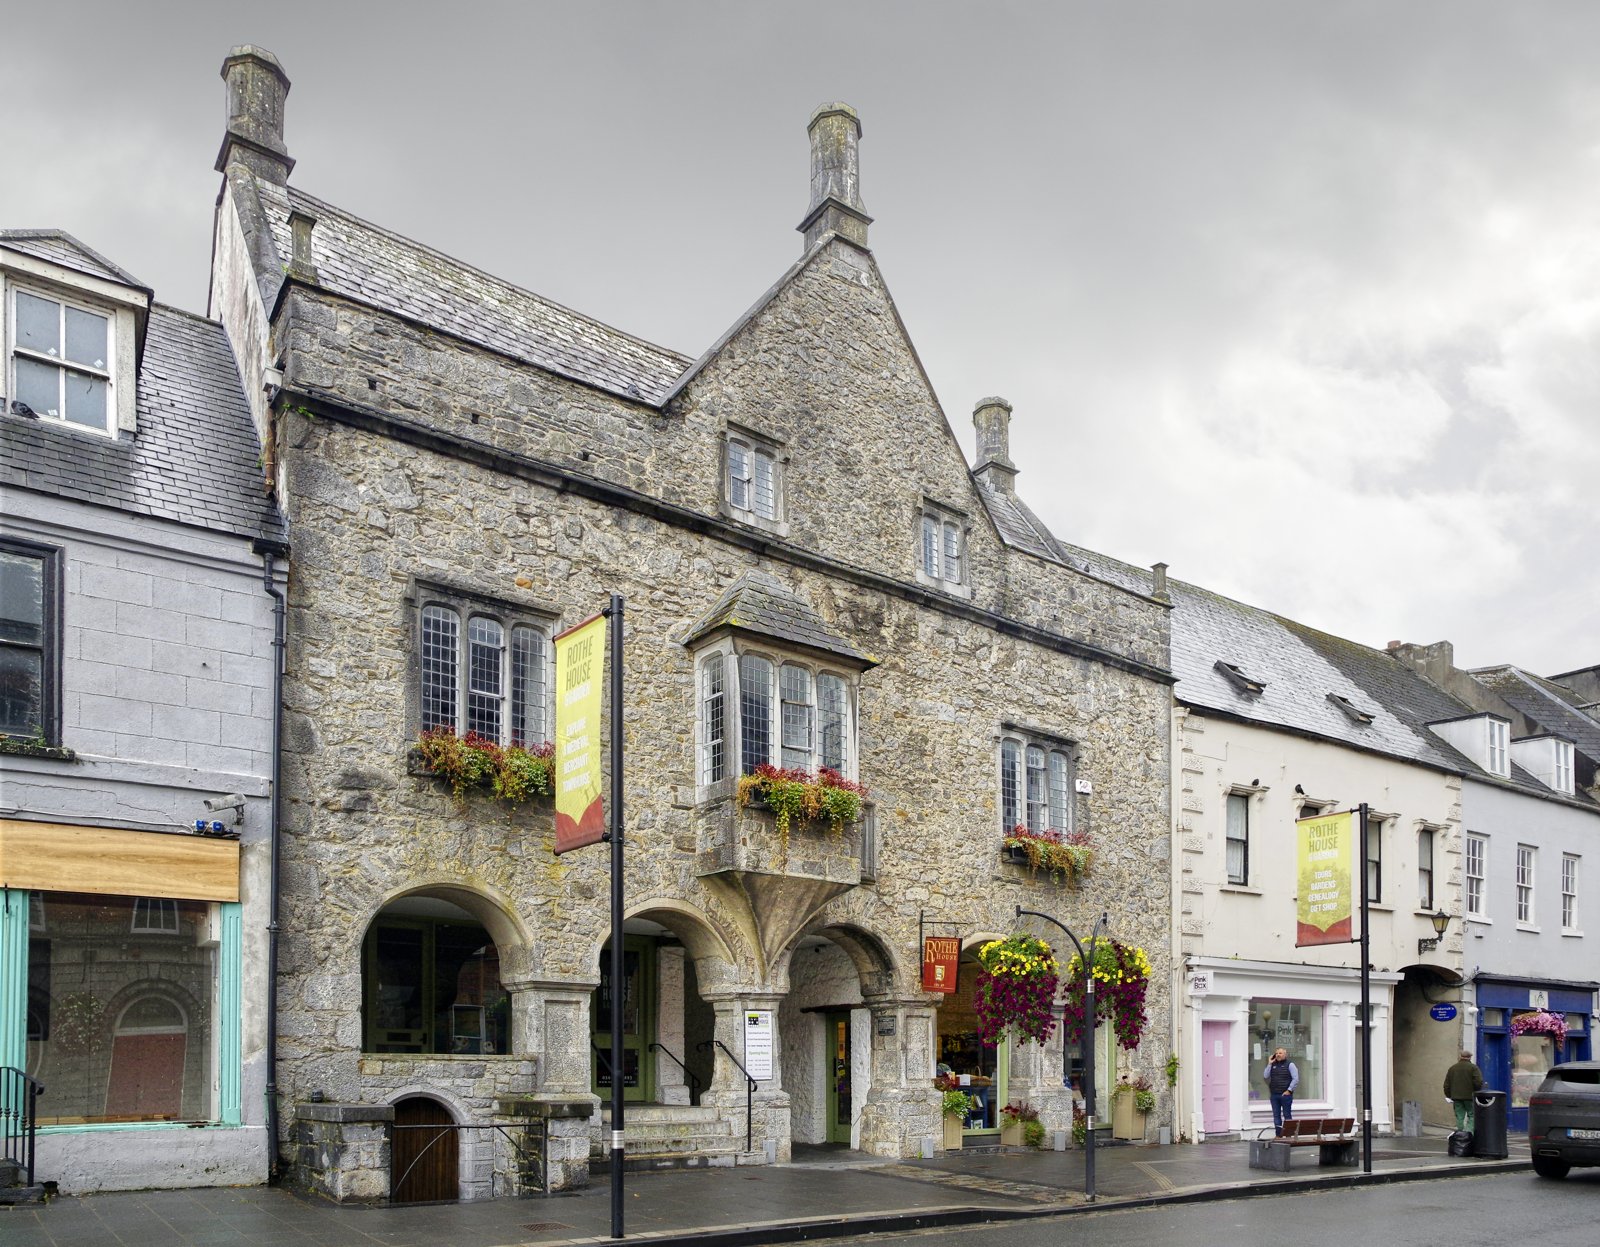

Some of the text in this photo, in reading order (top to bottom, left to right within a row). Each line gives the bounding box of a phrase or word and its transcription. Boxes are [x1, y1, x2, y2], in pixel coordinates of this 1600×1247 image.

[567, 635, 593, 668] ROTHE
[566, 660, 592, 691] HOUSE
[1308, 822, 1339, 839] ROTHE
[1308, 836, 1339, 853] HOUSE
[1314, 870, 1332, 879] TOURS
[1310, 880, 1336, 891] GARDENS
[1308, 891, 1339, 902] GENEALOGY
[1310, 902, 1338, 913] GIFT SHOP
[925, 940, 958, 963] ROTHE
[936, 952, 957, 961] HOUSE
